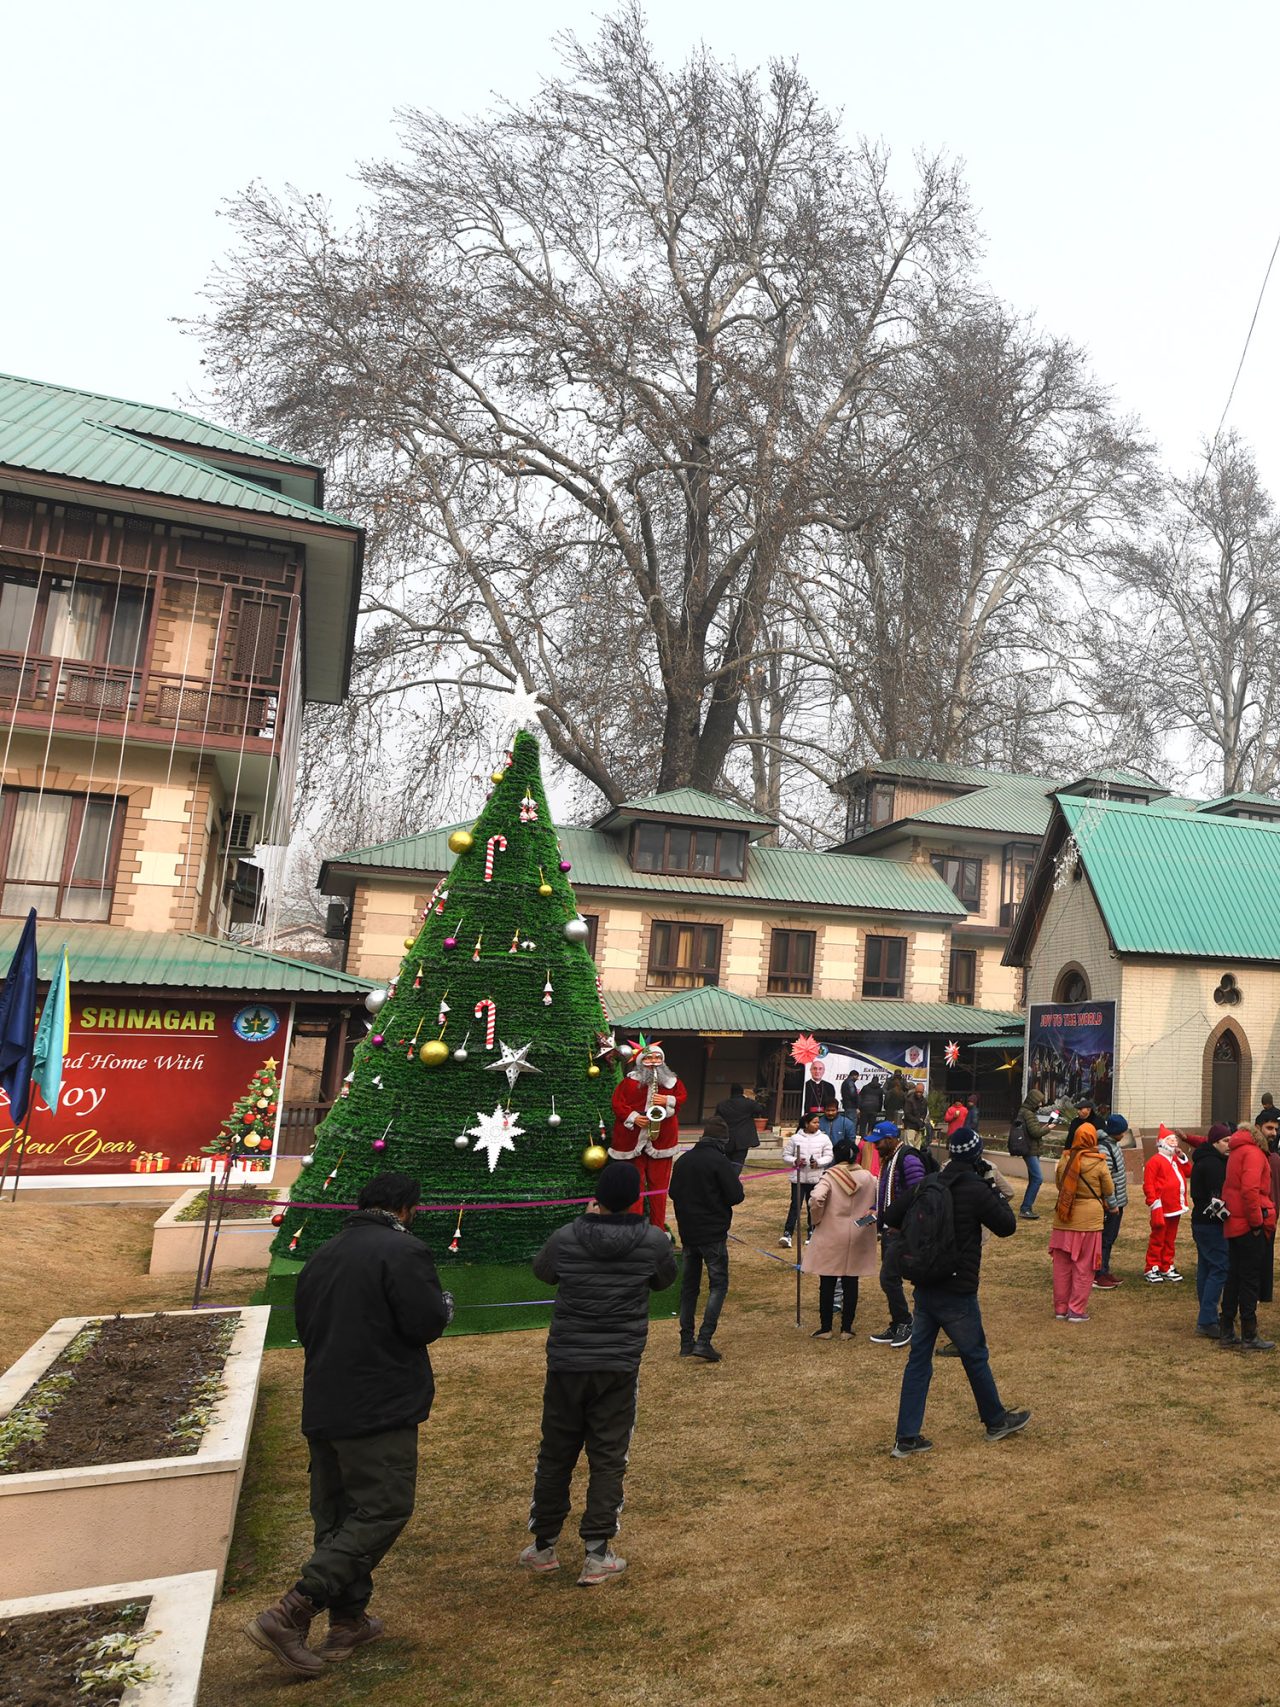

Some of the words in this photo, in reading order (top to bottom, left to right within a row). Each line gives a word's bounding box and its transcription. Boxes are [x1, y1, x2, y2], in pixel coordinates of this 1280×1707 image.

[80, 1006, 216, 1031] SRINAGAR
[1063, 1013, 1077, 1026] THE
[62, 1053, 90, 1070] nd
[88, 1053, 148, 1070] Home
[153, 1054, 205, 1070] With
[836, 1073, 871, 1081] HETY
[0, 1127, 75, 1155] New
[63, 1129, 137, 1166] Year
